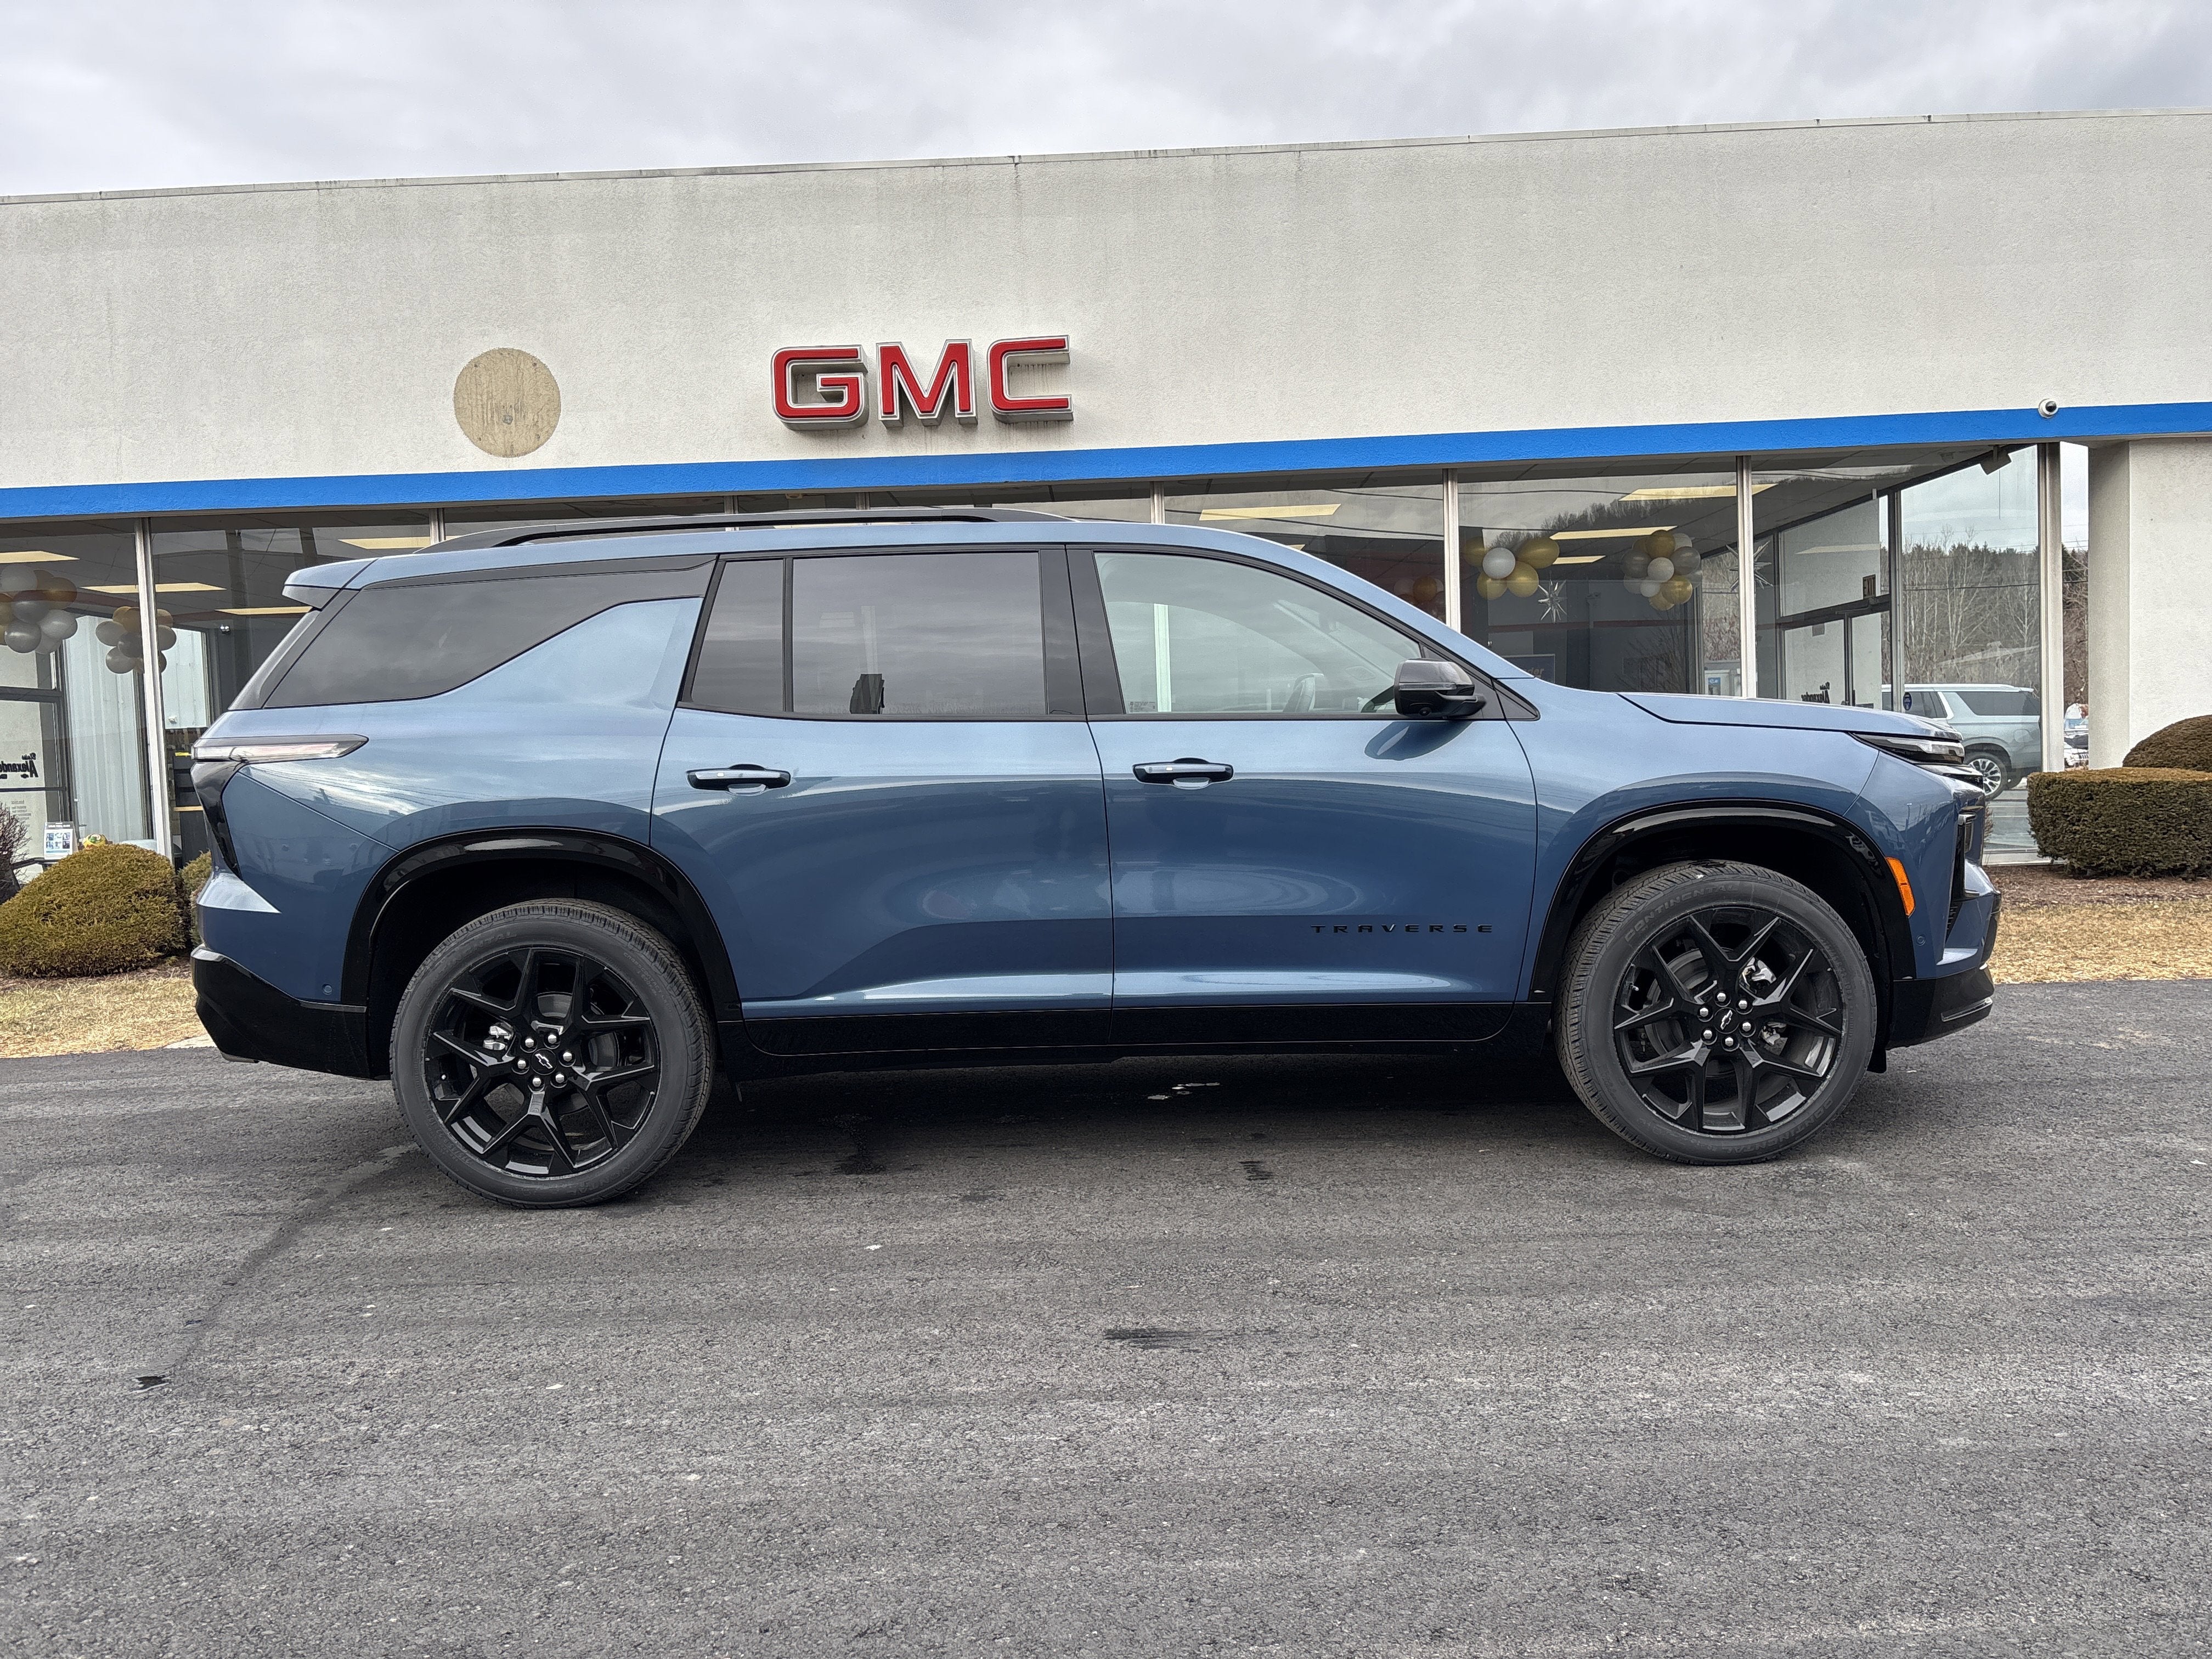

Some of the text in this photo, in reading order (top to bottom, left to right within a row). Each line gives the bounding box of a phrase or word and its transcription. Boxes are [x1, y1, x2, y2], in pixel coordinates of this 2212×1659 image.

[771, 335, 1073, 425] GMC
[1863, 576, 1875, 597] EXIT
[1311, 924, 1492, 933] TRAVERSE
[1624, 884, 1738, 942] CONTINENTAL
